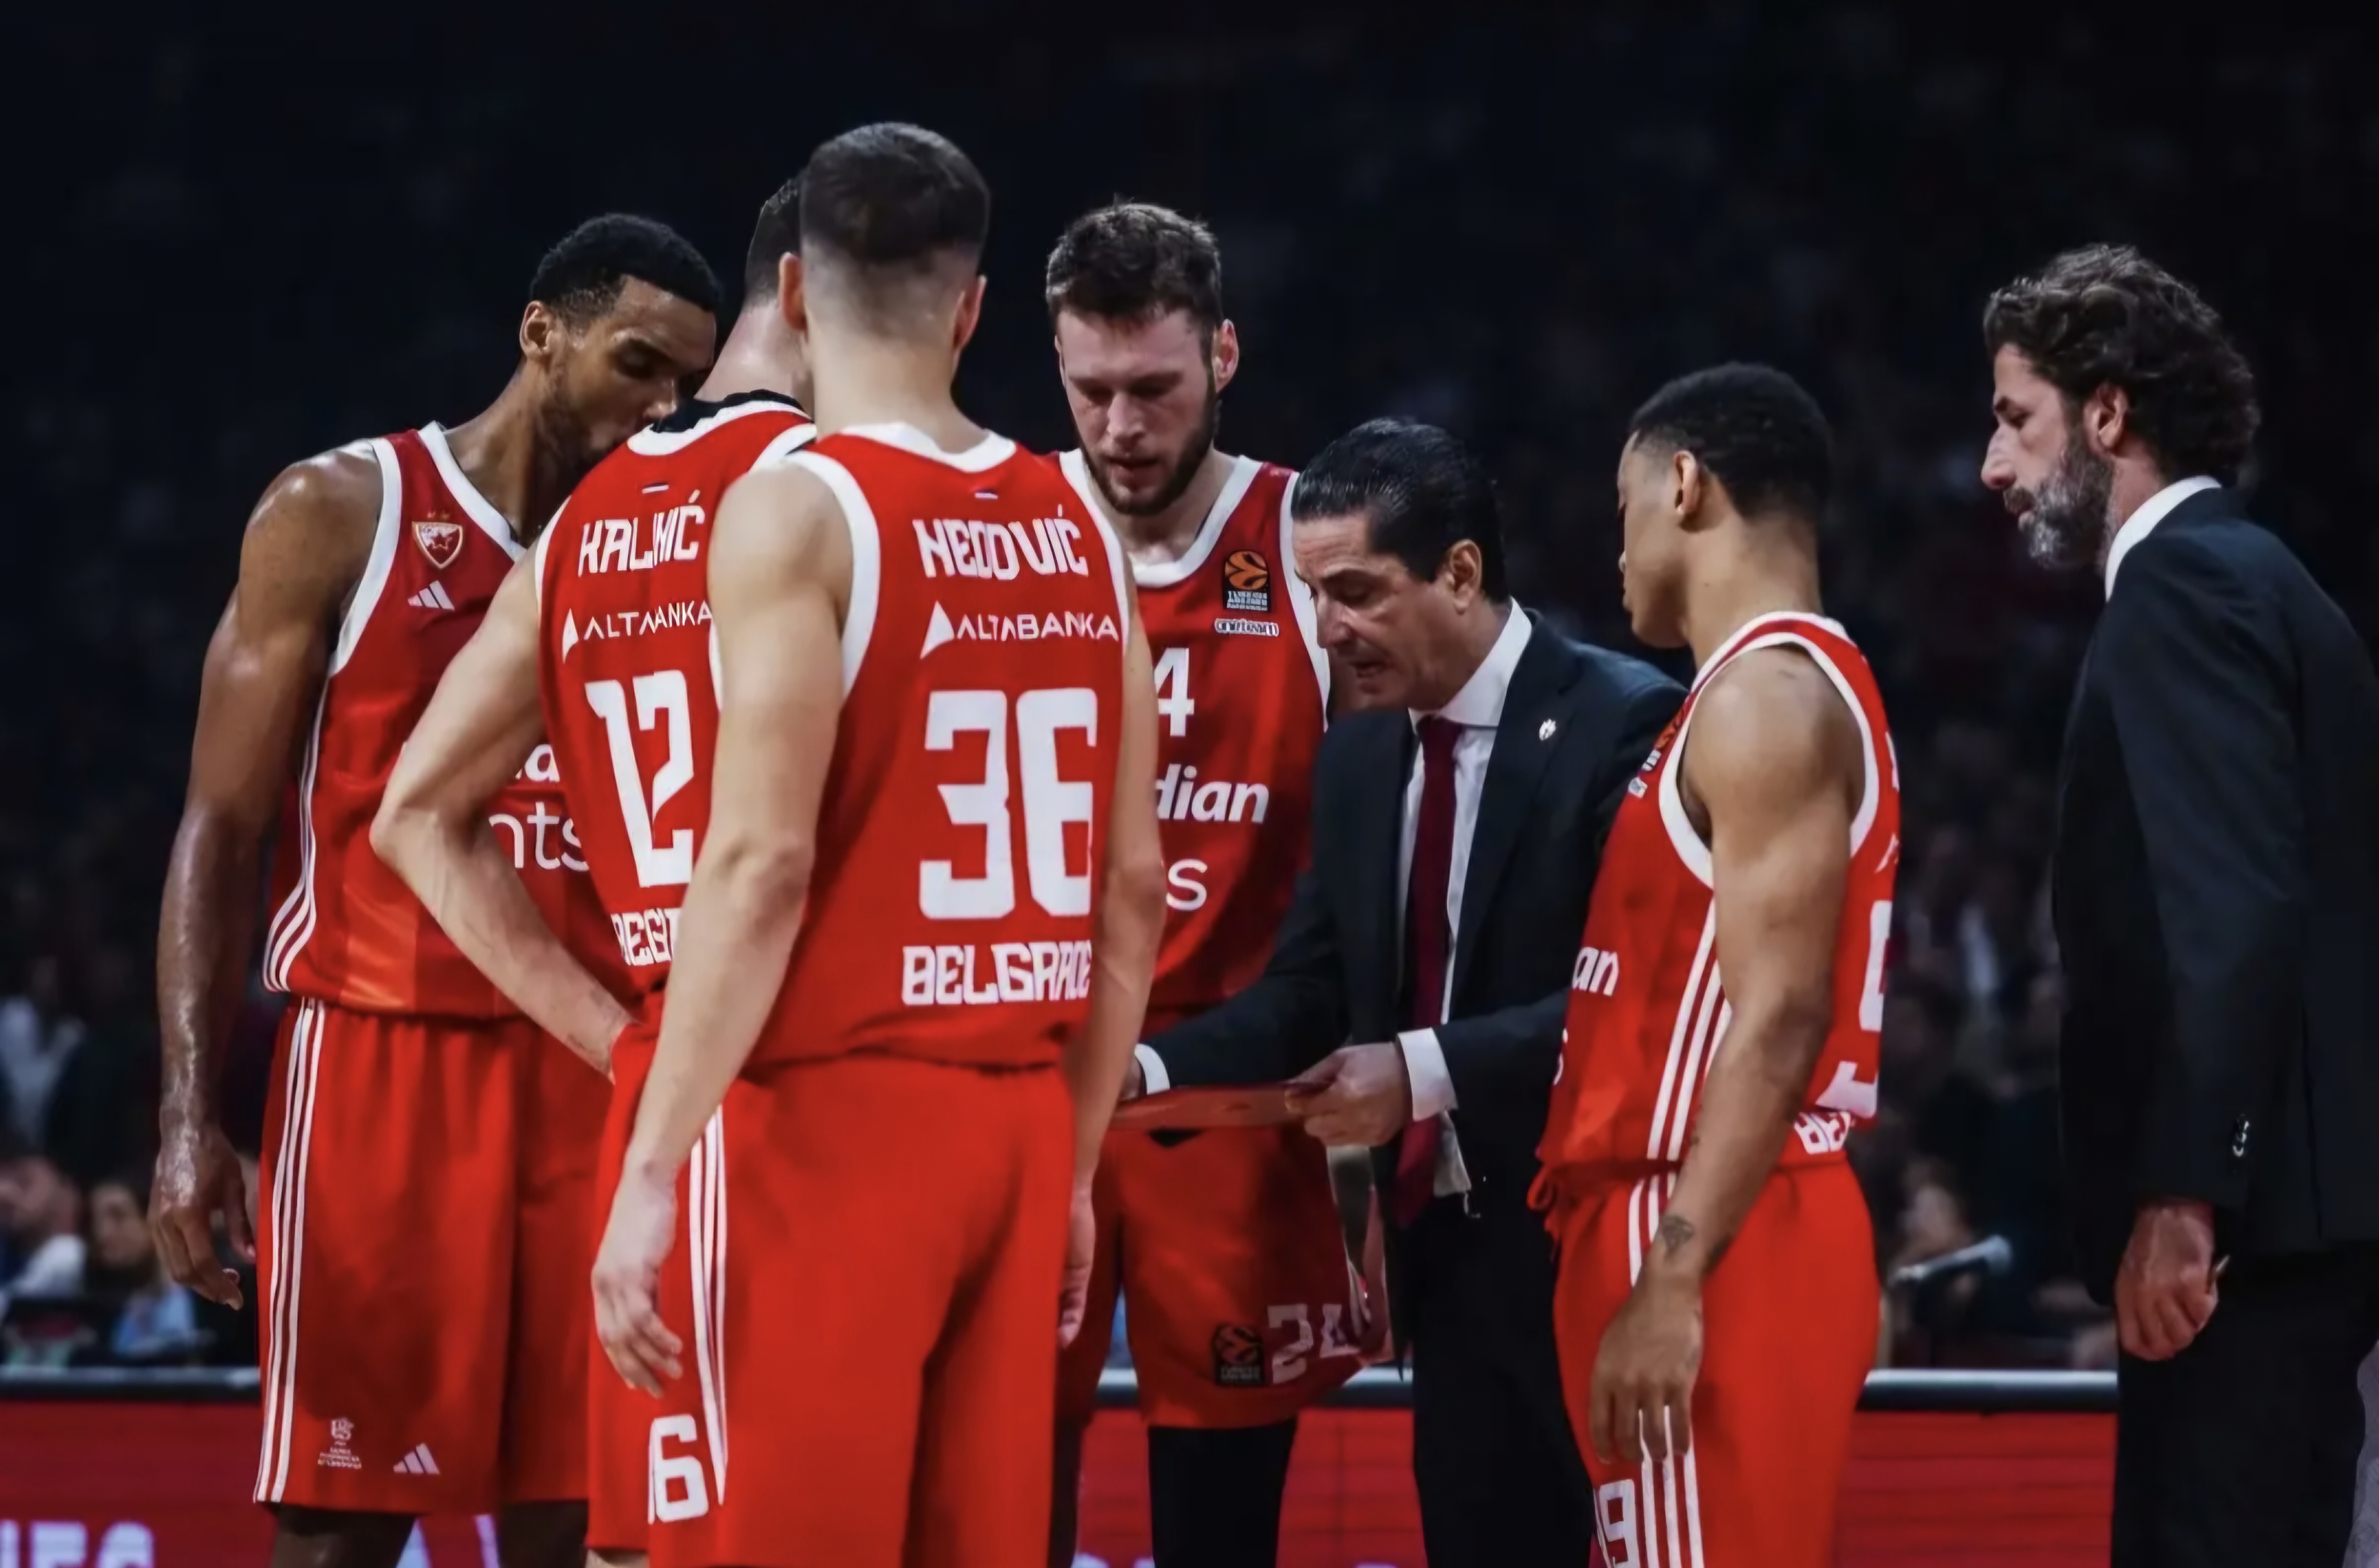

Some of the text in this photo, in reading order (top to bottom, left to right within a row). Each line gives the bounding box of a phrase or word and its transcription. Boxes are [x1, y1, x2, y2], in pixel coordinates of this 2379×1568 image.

[957, 611, 1118, 641] ALTABANKA
[585, 669, 694, 888] 12
[919, 688, 1098, 919] 36
[648, 1413, 709, 1525] 6
[1593, 1479, 1641, 1568] 9
